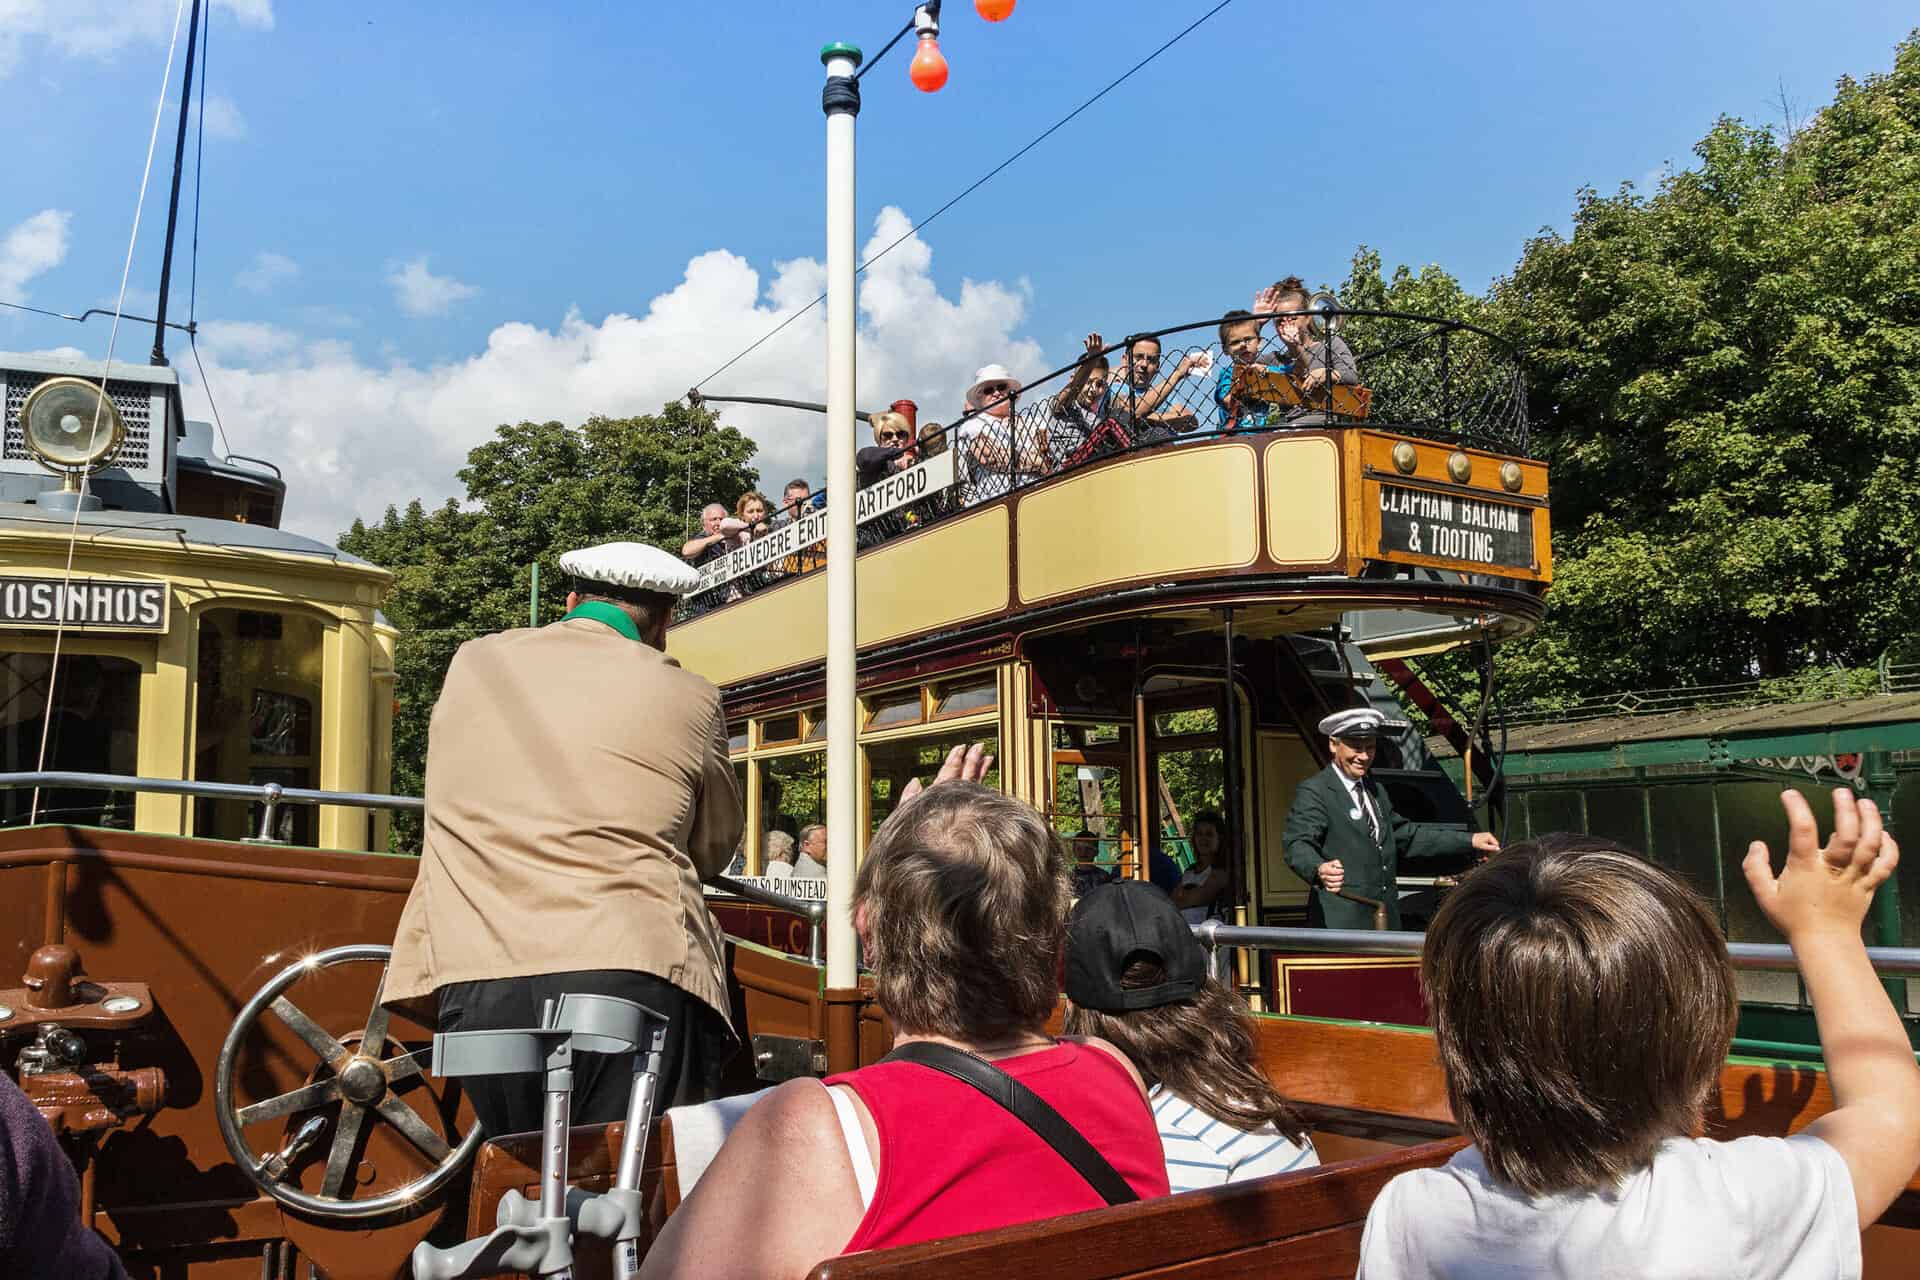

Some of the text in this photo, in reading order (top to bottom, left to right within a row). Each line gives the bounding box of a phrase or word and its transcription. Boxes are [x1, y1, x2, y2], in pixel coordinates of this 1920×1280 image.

[731, 466, 927, 575] BELVEDERE ERIT ARTFORD
[1380, 485, 1519, 533] CLAPHAM BALHAM
[1408, 521, 1494, 563] & TOOTING
[0, 582, 160, 624] OSINHOS
[774, 877, 826, 899] PLUMSTEAD
